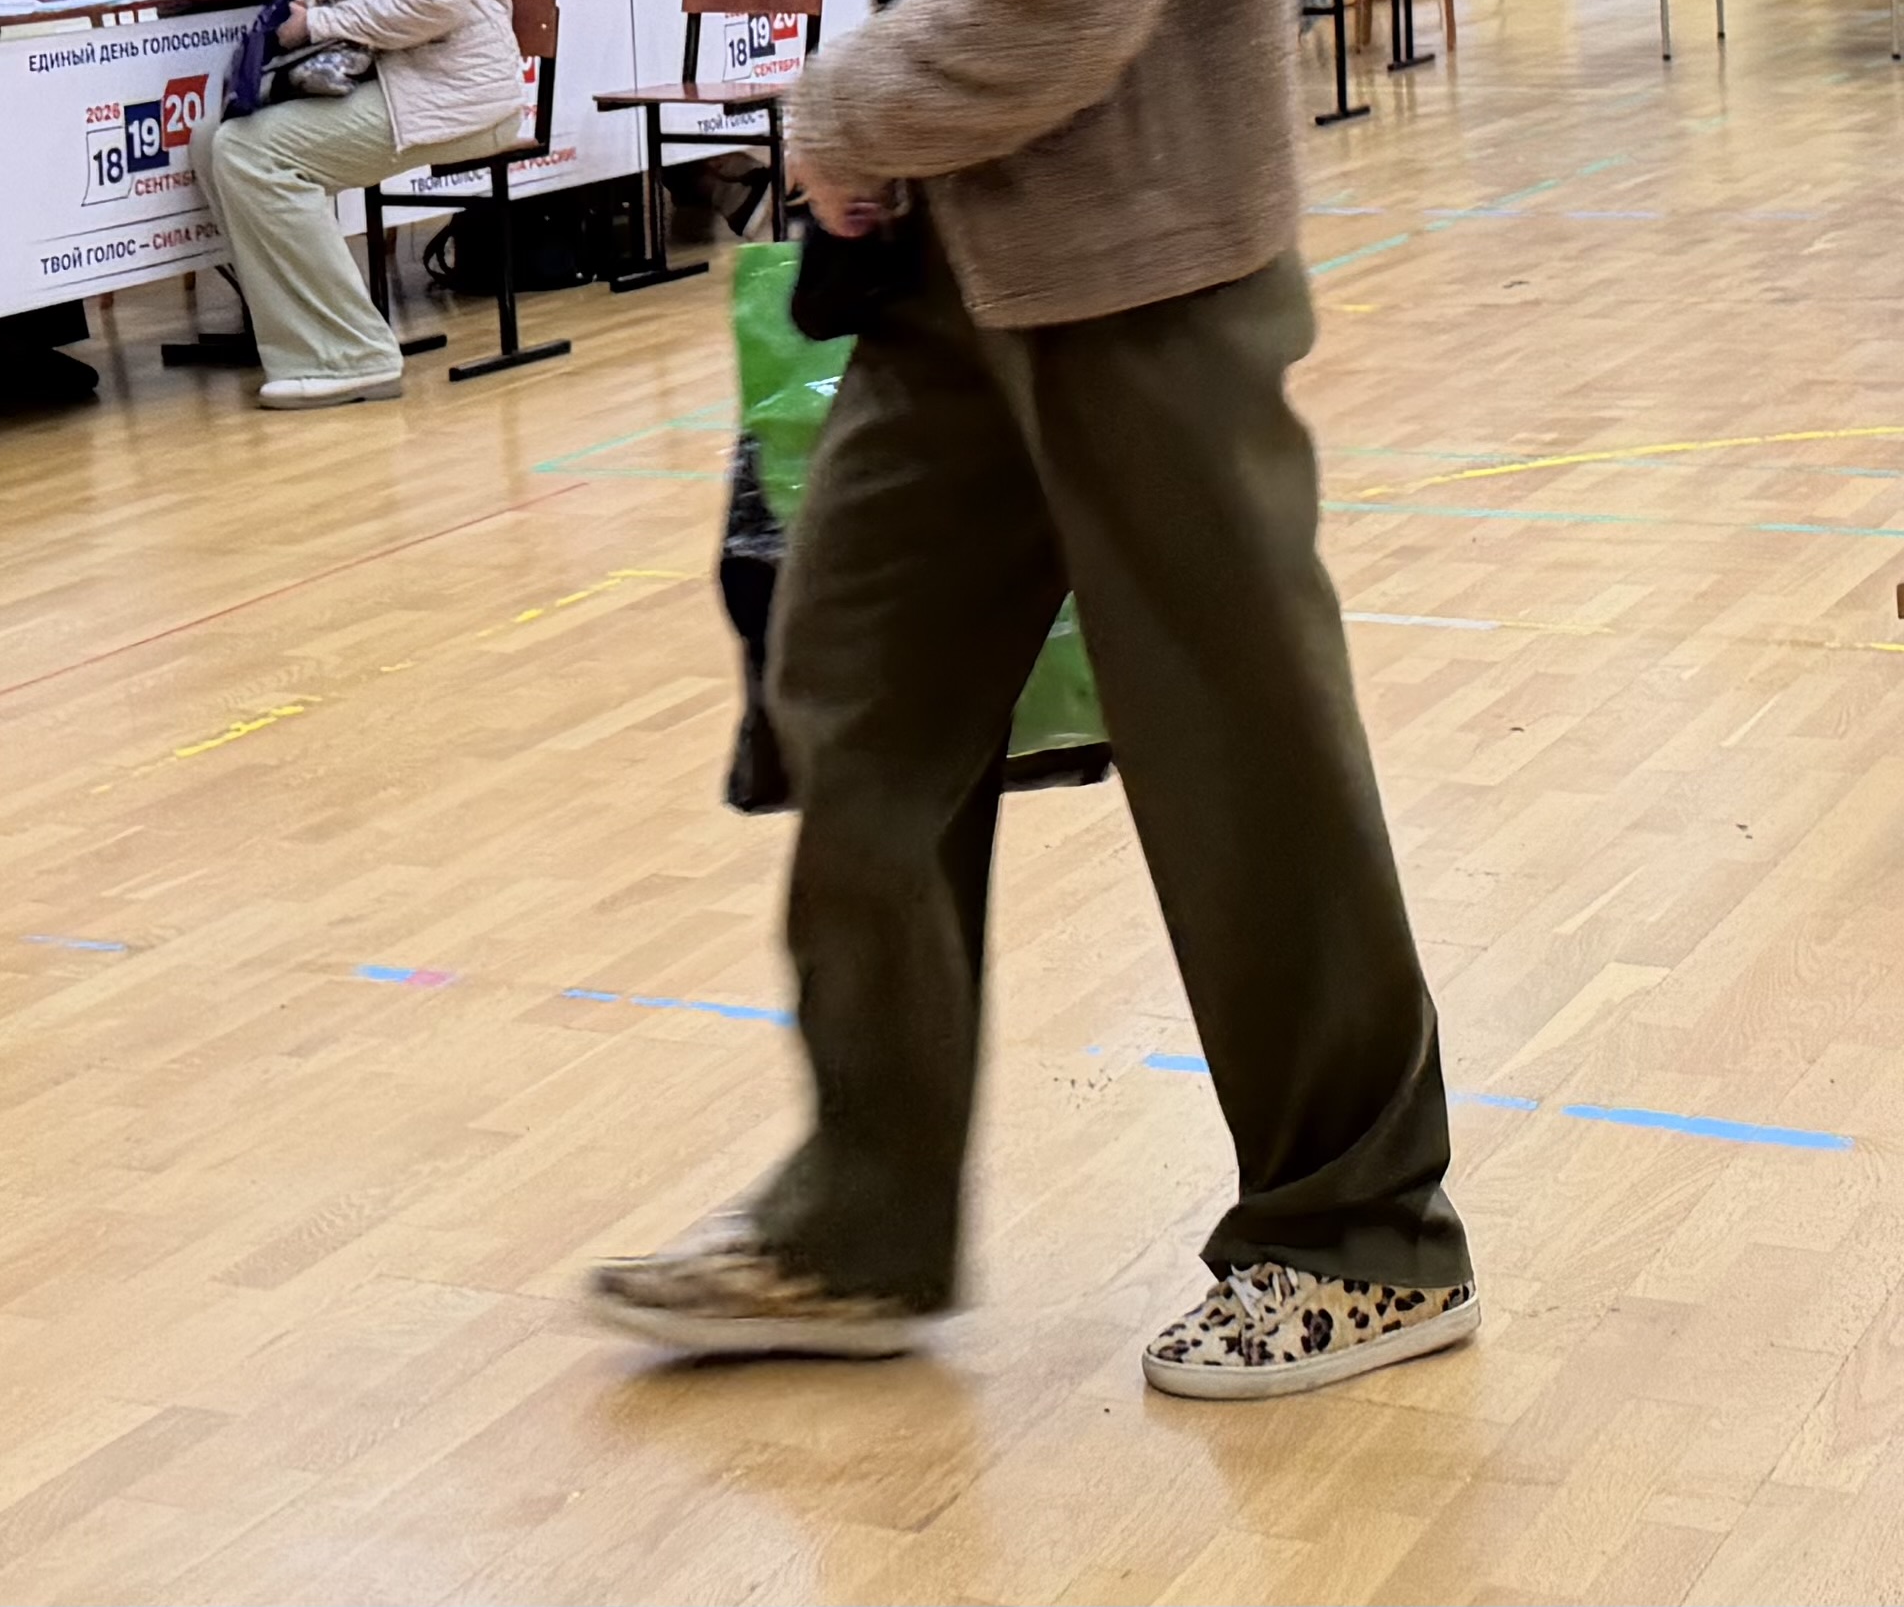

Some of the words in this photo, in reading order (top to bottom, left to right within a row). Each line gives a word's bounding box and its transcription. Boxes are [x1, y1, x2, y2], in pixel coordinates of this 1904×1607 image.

[28, 43, 97, 74] ЕДИНЫЙ
[99, 39, 140, 66] ДЕНЬ
[728, 37, 748, 68] 18
[750, 15, 771, 49] 19
[93, 147, 124, 186] 18
[128, 118, 161, 160] 19
[166, 91, 203, 132] 20
[40, 247, 83, 276] ТВОЙ
[86, 237, 137, 267] ГОЛОС
[152, 227, 192, 251] СИЛА
